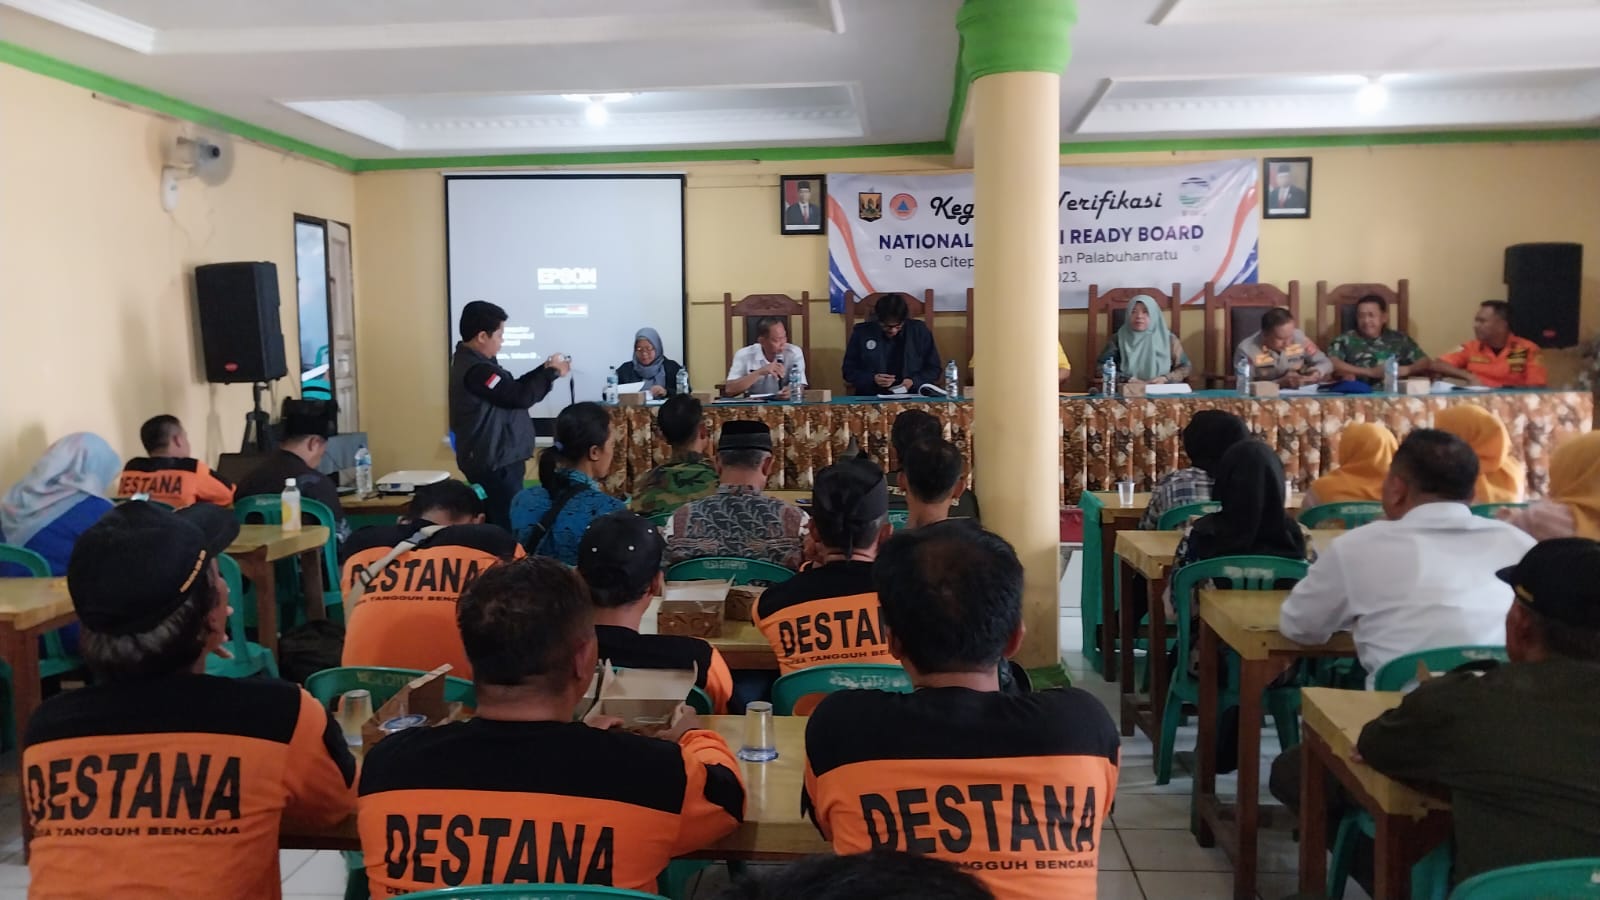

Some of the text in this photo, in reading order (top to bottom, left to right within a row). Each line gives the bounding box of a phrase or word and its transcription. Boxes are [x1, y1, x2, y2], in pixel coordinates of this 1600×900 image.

[930, 196, 974, 225] Keg
[879, 233, 974, 249] NATIONAL
[1070, 227, 1132, 244] READY
[1138, 225, 1204, 242] BOARD
[904, 257, 937, 268] Desa
[1076, 250, 1178, 264] Palabuhanratu
[27, 752, 241, 824] DESTANA
[57, 827, 140, 836] TANGGUH
[147, 826, 241, 836] BENCANA
[859, 783, 1097, 854] DESTANA
[384, 814, 615, 886] DESTANA
[1035, 860, 1094, 870] BENCANA
